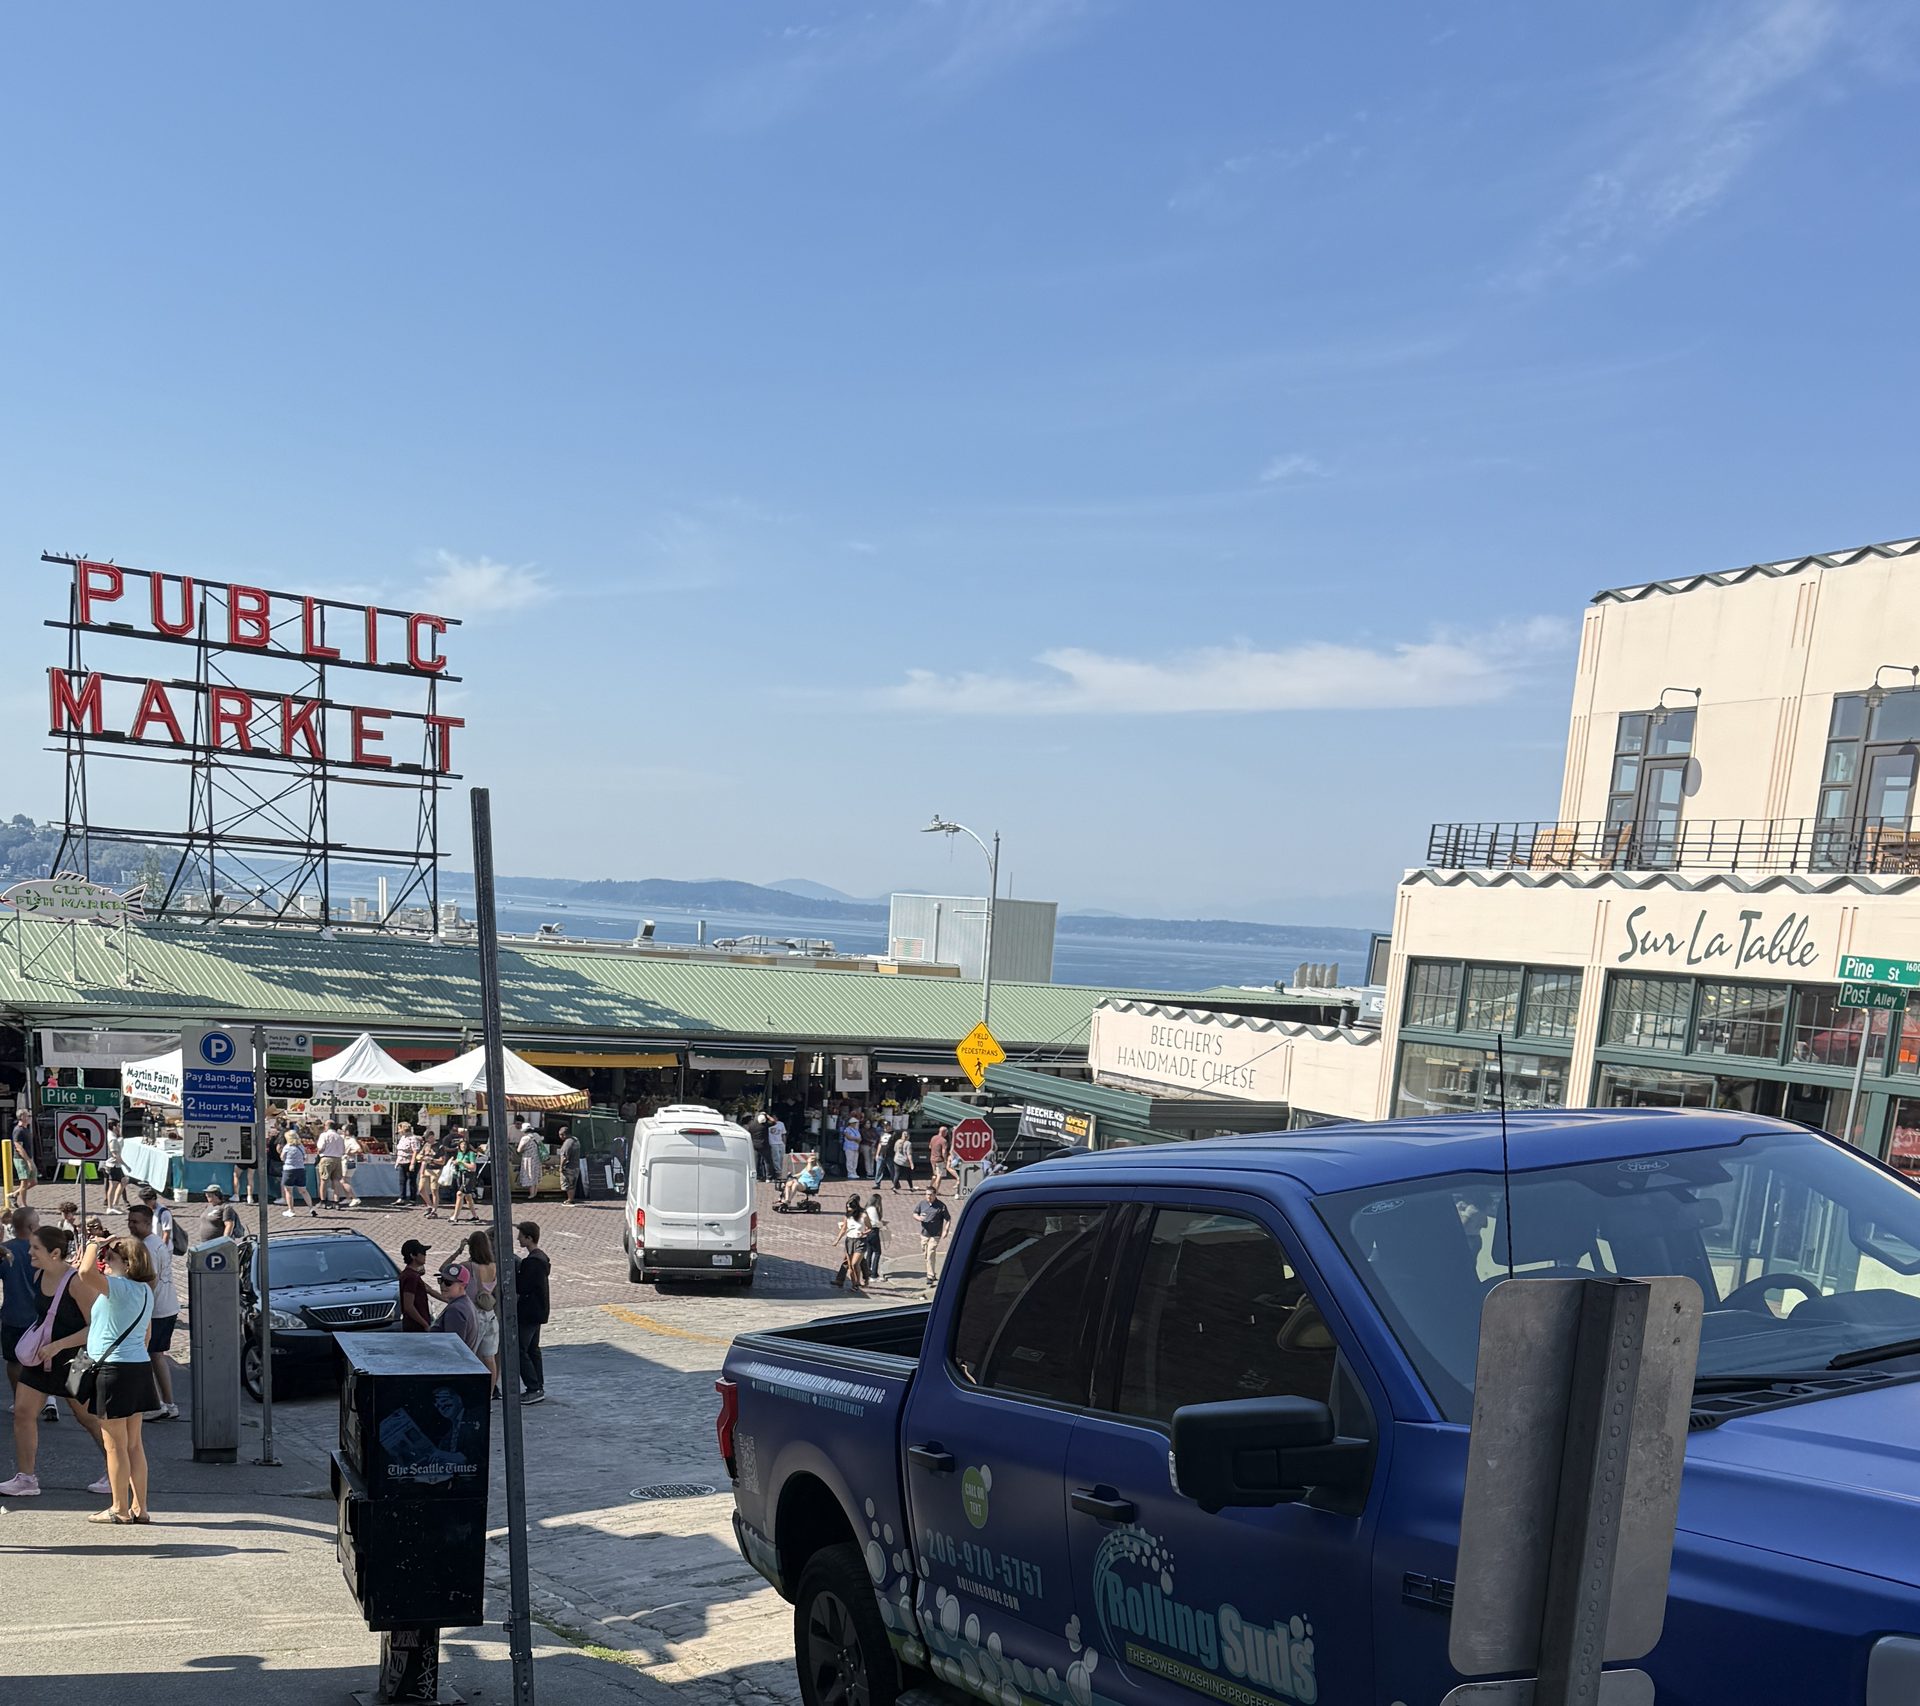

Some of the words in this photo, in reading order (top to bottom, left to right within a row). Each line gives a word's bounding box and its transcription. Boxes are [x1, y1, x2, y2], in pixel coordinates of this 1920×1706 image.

[75, 559, 447, 672] PUBLIC
[48, 666, 466, 773] MARKET
[52, 884, 96, 896] CITY
[15, 895, 55, 907] FISH
[61, 897, 129, 911] MARKET
[1618, 905, 1685, 963] Sur
[1686, 909, 1733, 966] La
[1734, 909, 1820, 970] Table
[1844, 957, 1875, 979] Pine
[1888, 966, 1901, 981] St
[1843, 984, 1871, 1005] Post
[1873, 993, 1898, 1009] Alley
[973, 1032, 989, 1041] YIELD
[977, 1040, 984, 1048] TO
[1150, 1025, 1223, 1056] BEECHER'S
[210, 1038, 228, 1059] P
[961, 1046, 999, 1057] PEDESTRIANS
[1117, 1046, 1198, 1079] HANDMADE
[1202, 1060, 1257, 1090] CHEESE
[127, 1066, 152, 1081] Martin
[154, 1071, 179, 1088] Family
[185, 1072, 203, 1082] Pay
[205, 1073, 251, 1084] 8am-8pm
[269, 1076, 310, 1089] 87505
[134, 1079, 170, 1095] Orchards
[47, 1088, 77, 1103] Pike
[85, 1094, 95, 1104] Pl
[367, 1089, 452, 1103] SLUSHIES
[514, 1095, 560, 1110] ROASTED
[186, 1097, 196, 1110] 2
[198, 1101, 229, 1111] Hours
[231, 1103, 251, 1112] Max
[1066, 1115, 1089, 1128] OPEN
[955, 1131, 991, 1149] STOP
[828, 1379, 853, 1396] POWER
[850, 1384, 886, 1404] WASHING
[387, 1463, 409, 1476] The
[409, 1462, 444, 1476] Seattle
[444, 1462, 478, 1474] Times
[965, 1482, 977, 1498] CALL
[969, 1501, 982, 1517] TEXT
[926, 1527, 1043, 1600] 206-970-5757
[956, 1575, 1020, 1612] ROLLINGSUDS.COM
[1106, 1570, 1219, 1670] Rolling
[1218, 1603, 1318, 1705] Suds
[1127, 1647, 1146, 1665] THE
[1146, 1656, 1180, 1679] POWER
[1180, 1667, 1227, 1695] WASHING
